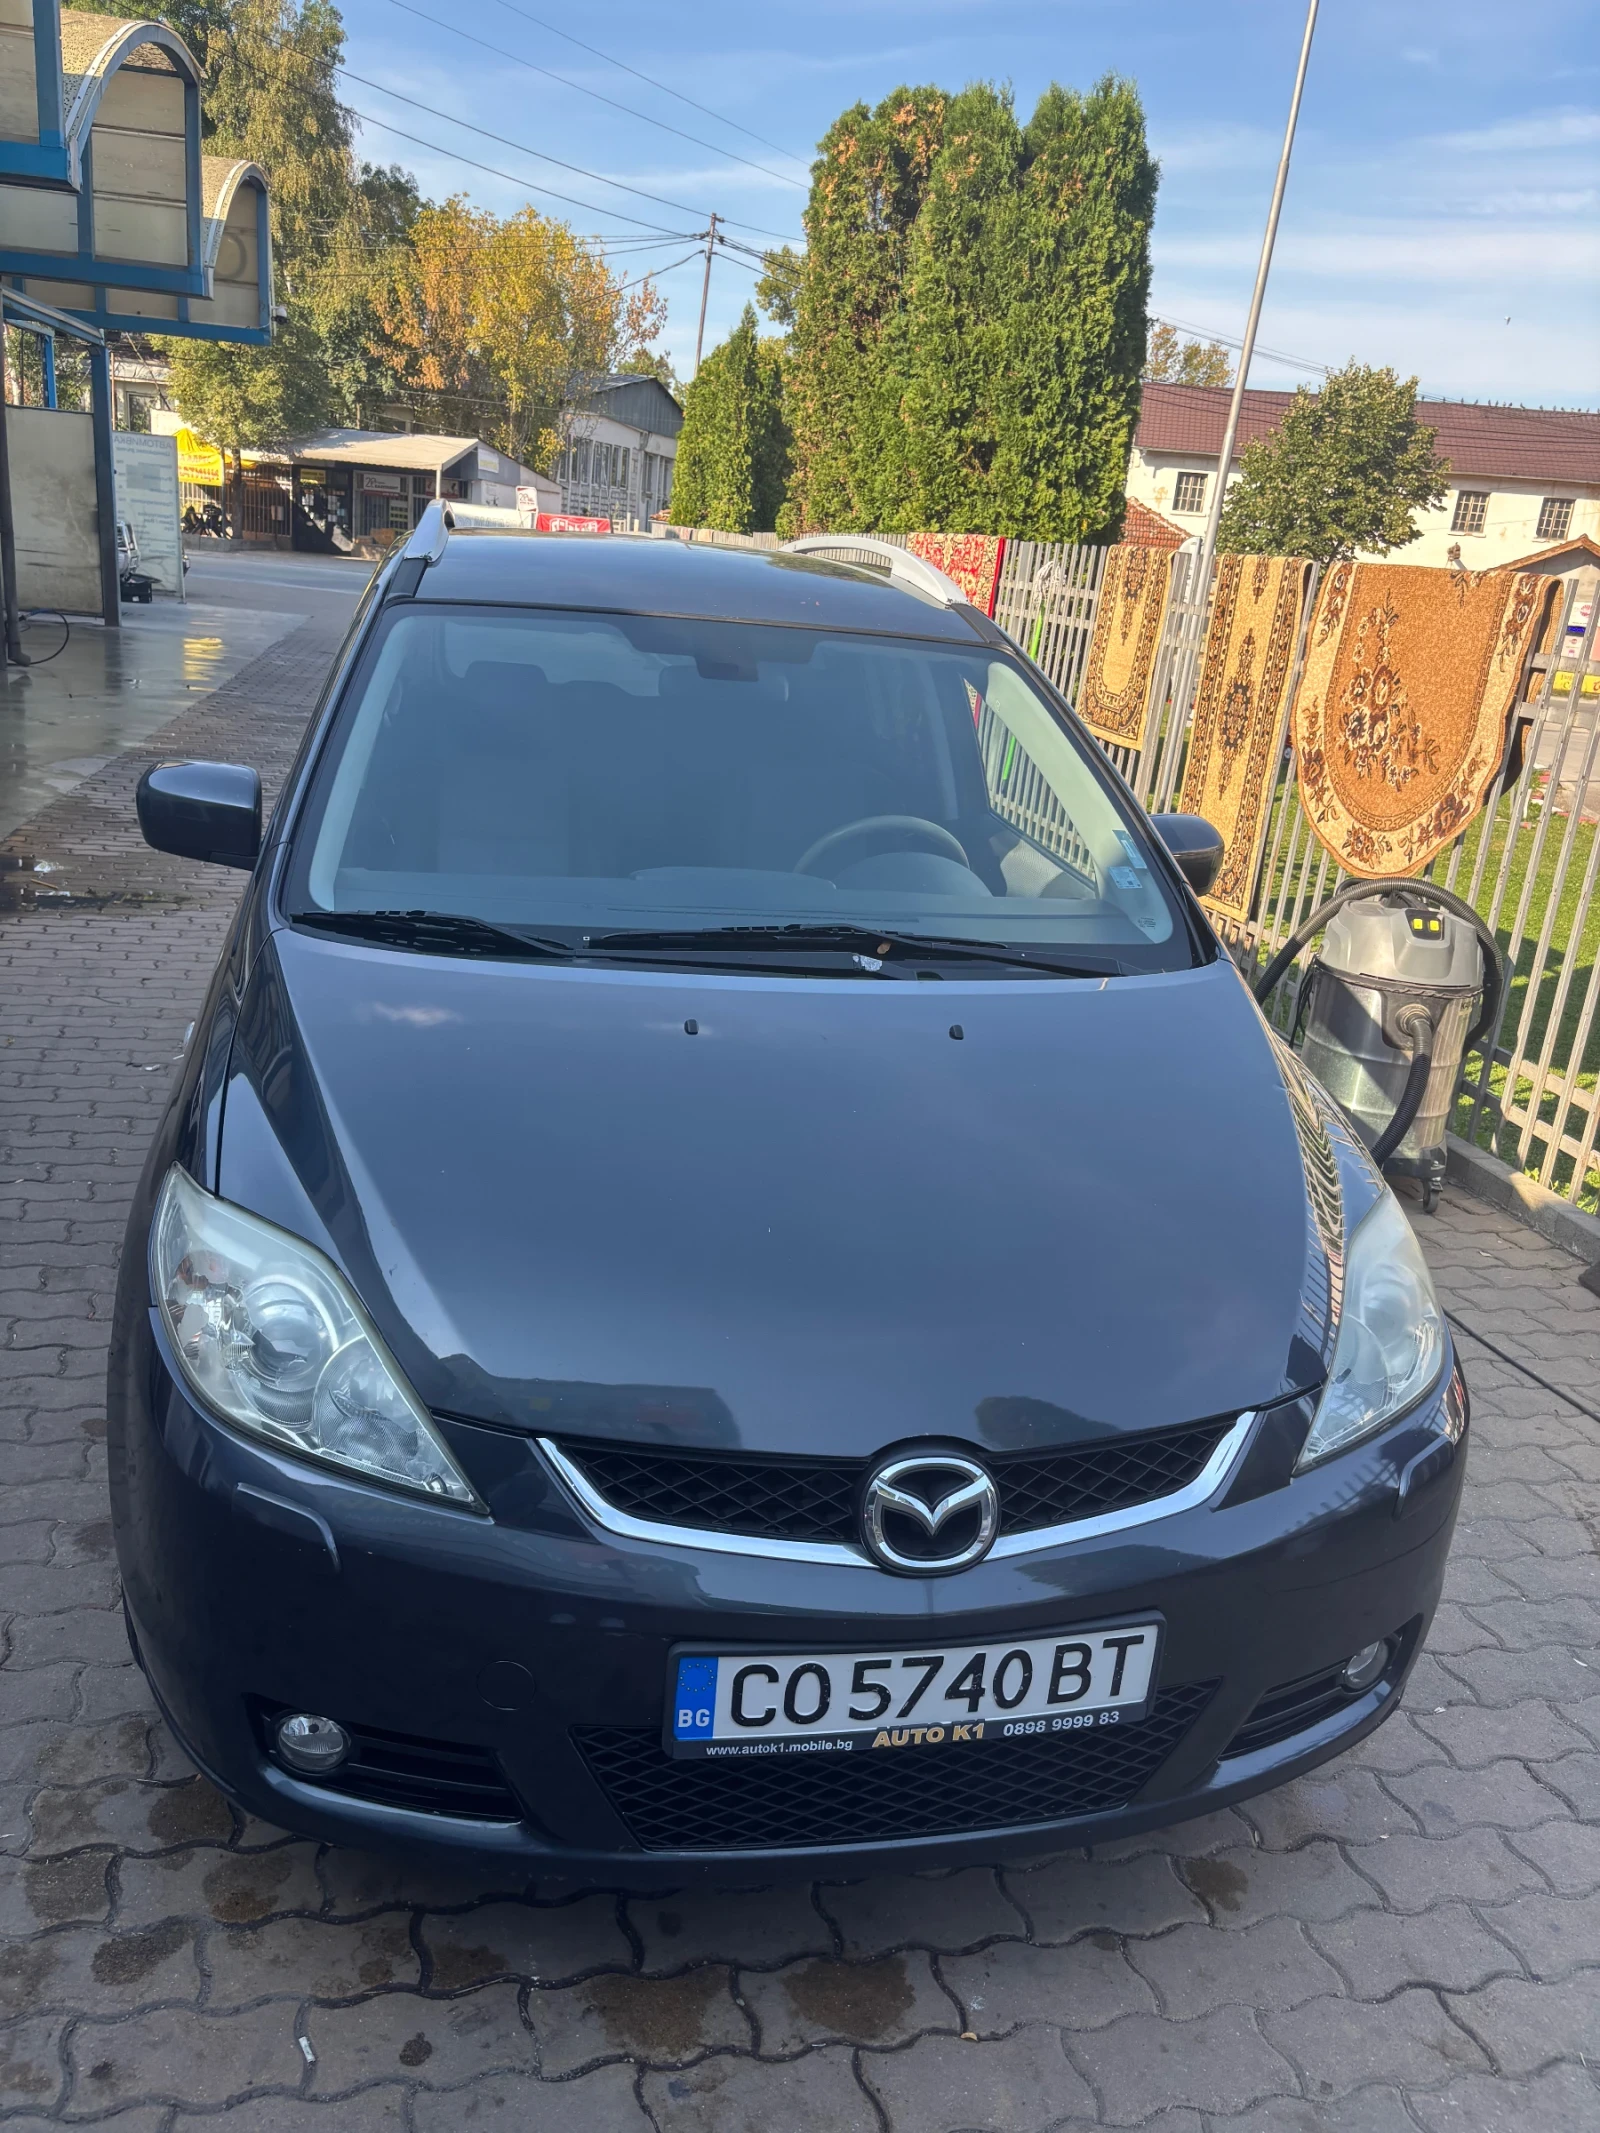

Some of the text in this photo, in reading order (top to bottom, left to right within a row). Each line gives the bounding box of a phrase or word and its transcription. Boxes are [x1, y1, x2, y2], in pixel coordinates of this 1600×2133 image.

[731, 1634, 1145, 1727] CO 5740 BT
[678, 1709, 710, 1728] BG
[706, 1711, 1120, 1755] www.autok1.mobile.bg AUTO K1 0898 9999 83
